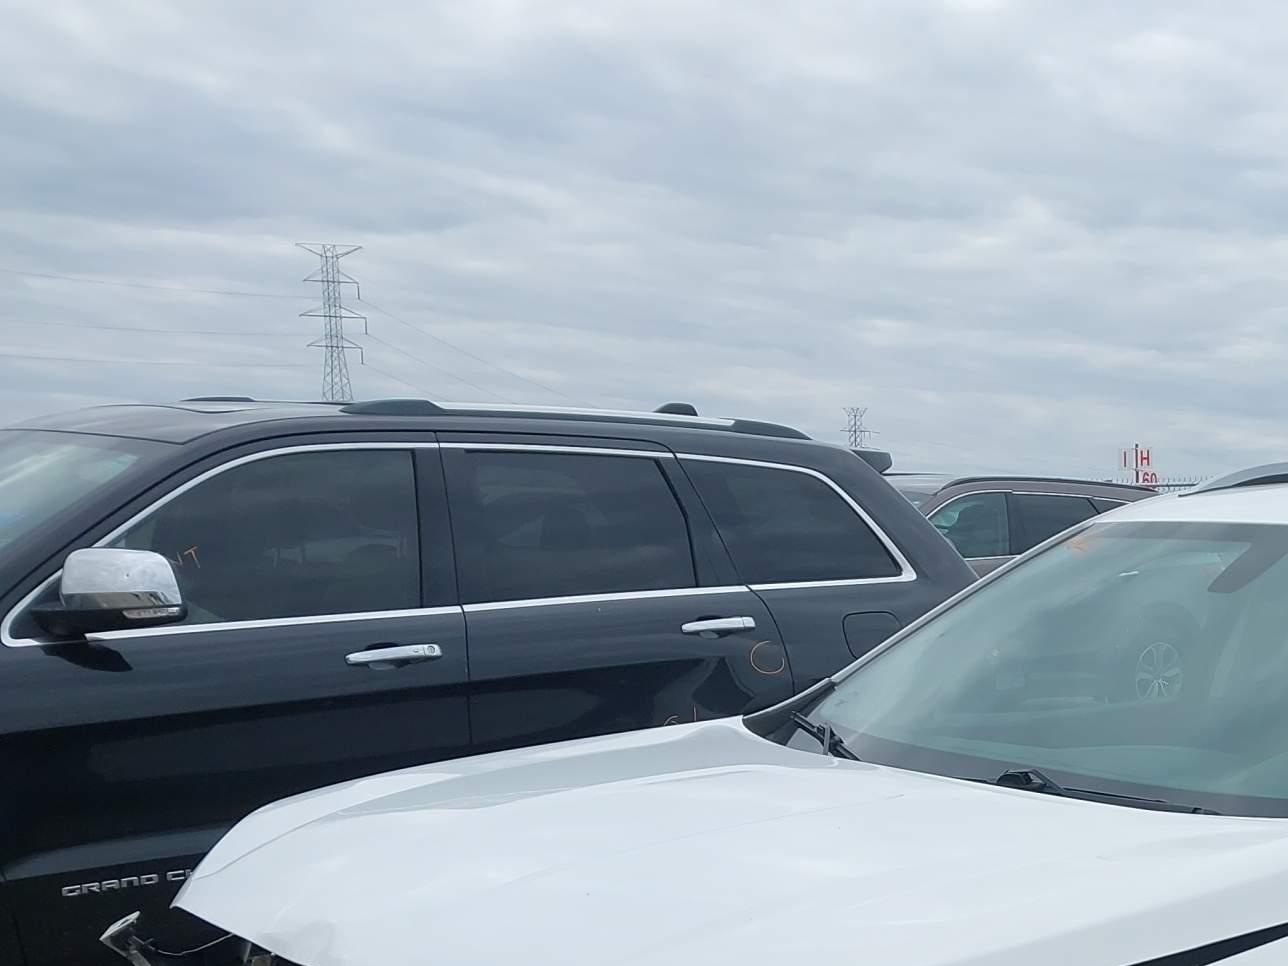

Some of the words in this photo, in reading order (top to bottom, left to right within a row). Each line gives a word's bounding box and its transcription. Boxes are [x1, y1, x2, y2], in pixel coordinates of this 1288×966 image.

[1140, 449, 1150, 466] H
[1142, 471, 1157, 488] 60
[62, 873, 159, 897] GRAND
